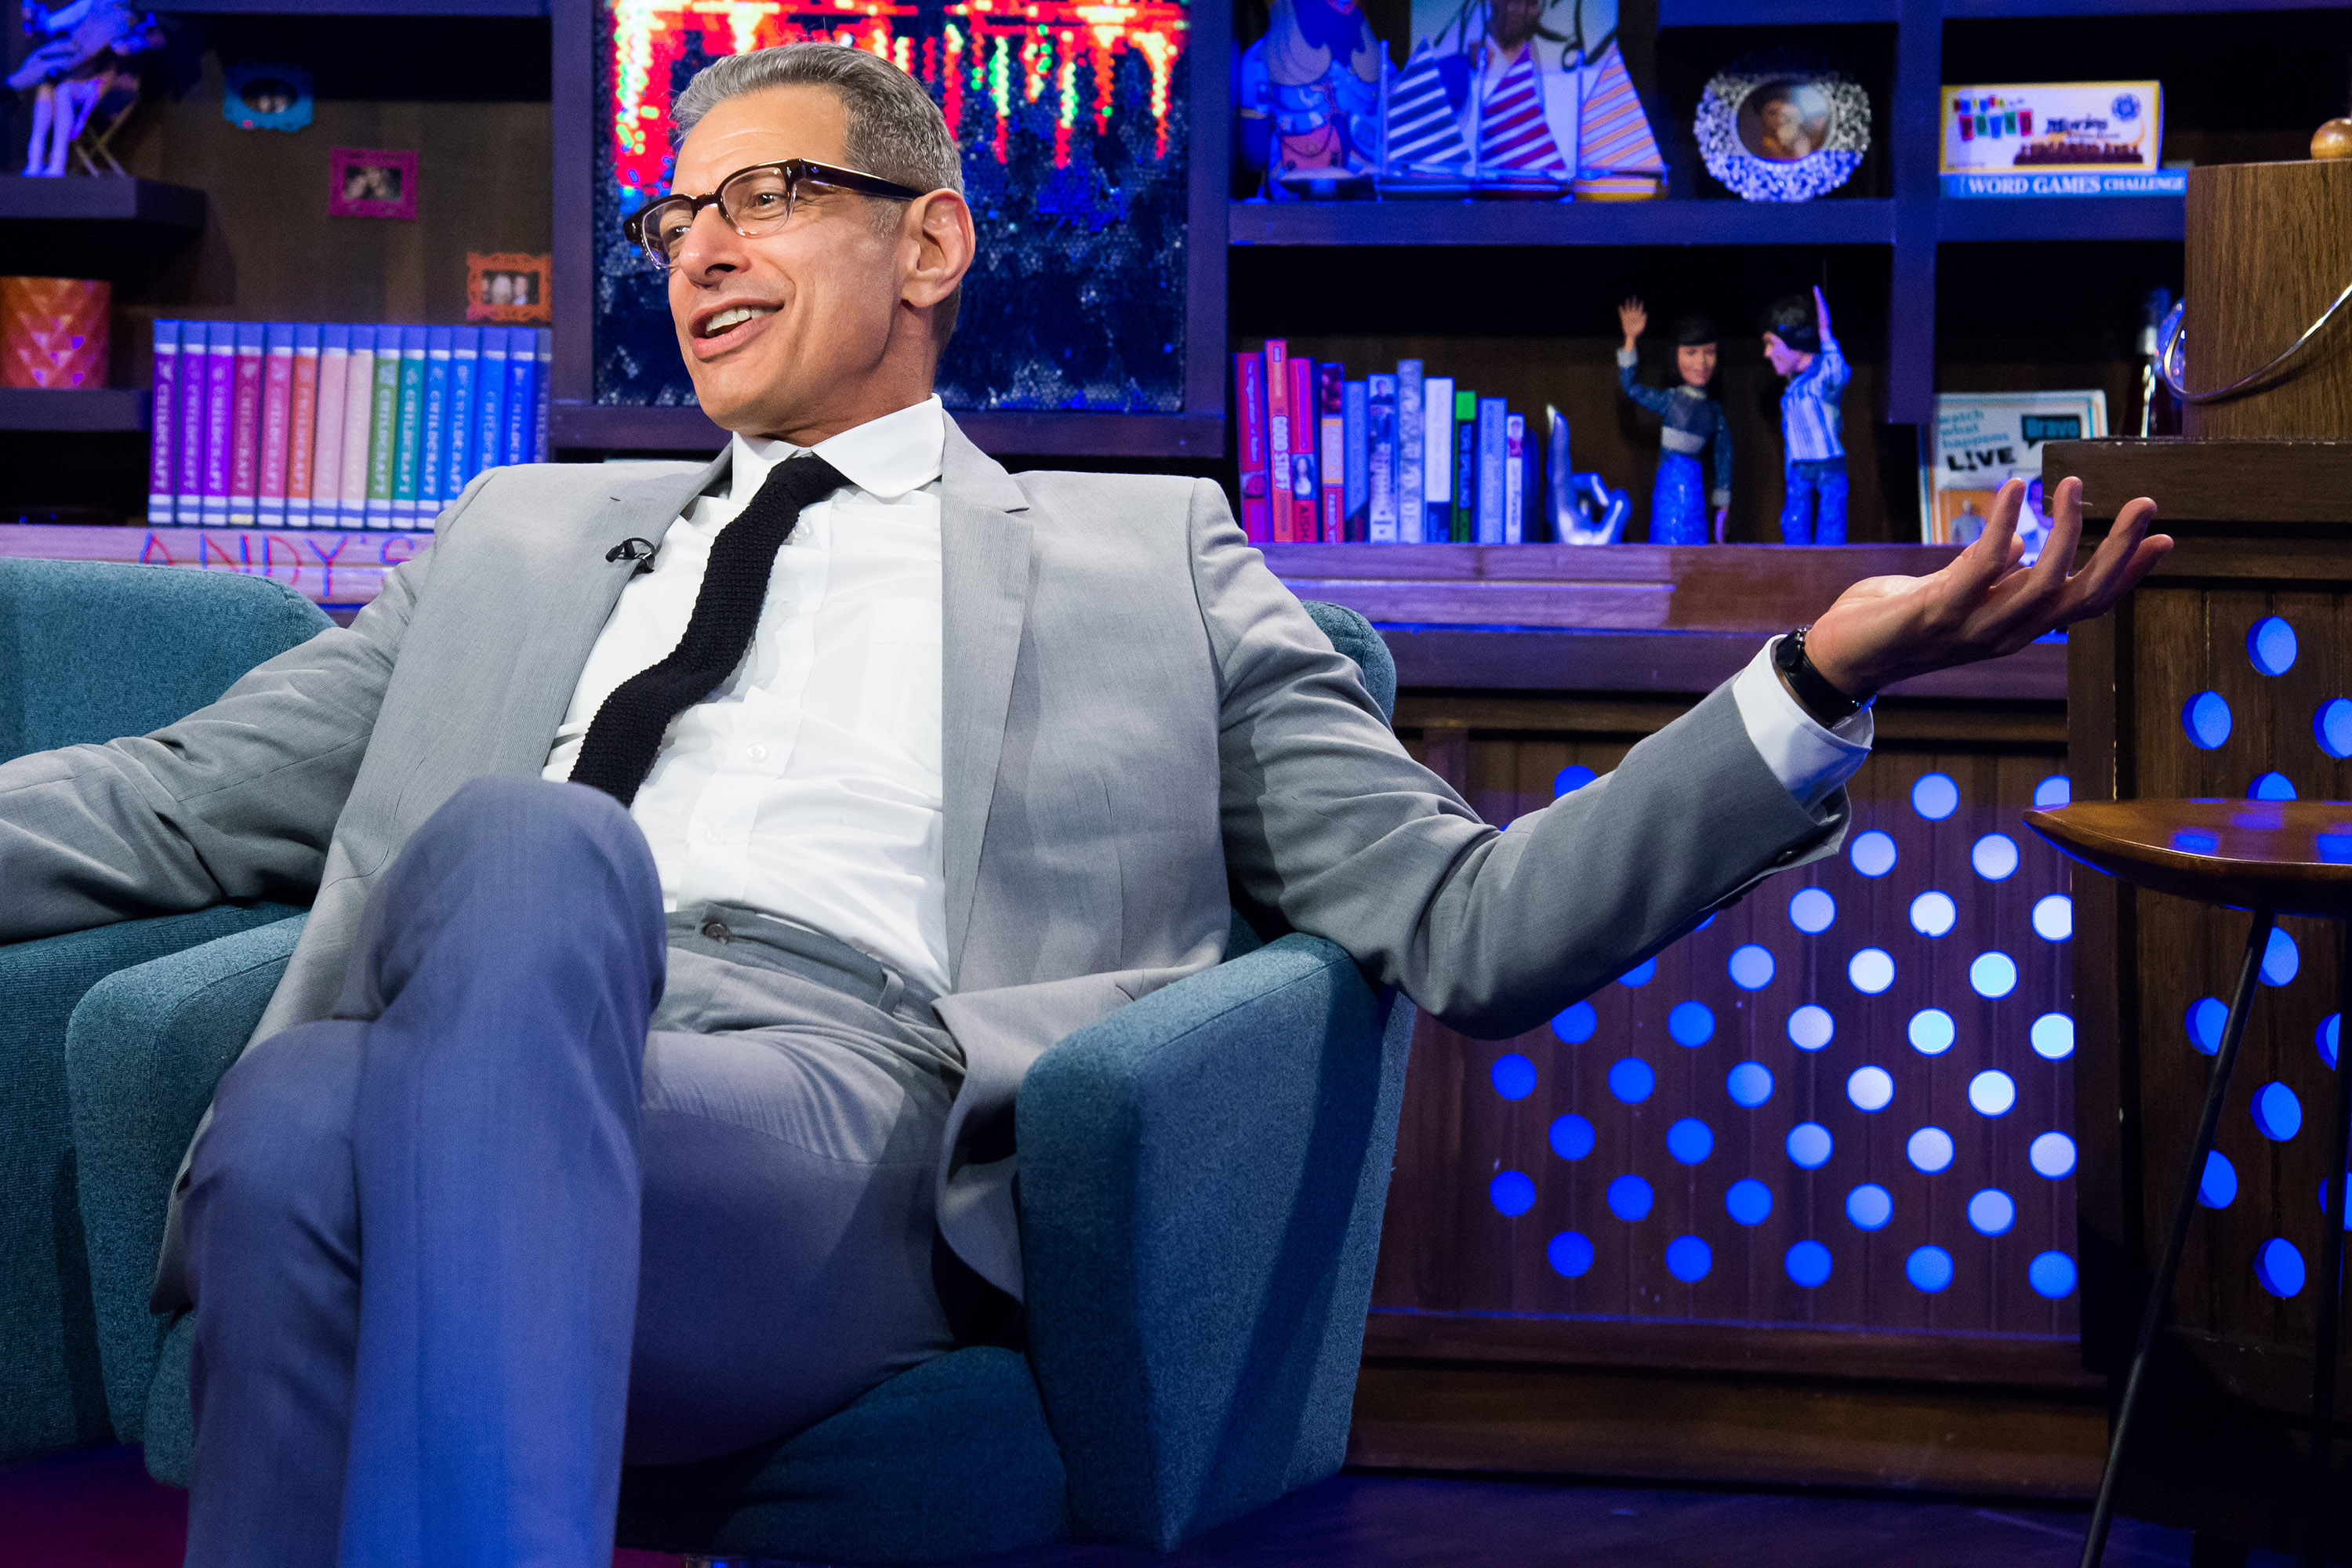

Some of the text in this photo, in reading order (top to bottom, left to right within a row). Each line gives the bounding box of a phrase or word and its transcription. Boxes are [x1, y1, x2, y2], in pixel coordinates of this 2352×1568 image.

[1967, 175, 2185, 194] WORD GAMES CHALLENGE
[154, 383, 172, 488] CHILDCRAFT
[184, 384, 201, 489] CHILDCRAFT
[209, 386, 226, 490] CHILDCRAFT
[266, 387, 284, 491] CHILDCRAFT
[293, 387, 310, 491] CHILDCRAFT
[374, 389, 392, 493] CHILDCRAFT
[398, 389, 416, 494] CHILDCRAFT
[423, 390, 441, 495] CHILDCRAFT
[449, 389, 467, 494] CHILDCRAFT
[481, 390, 497, 472] CHILDCR
[1271, 415, 1289, 452] GOOD
[1273, 452, 1291, 491] STUFF
[1943, 433, 2010, 448] happens
[1298, 505, 1310, 541] AISH
